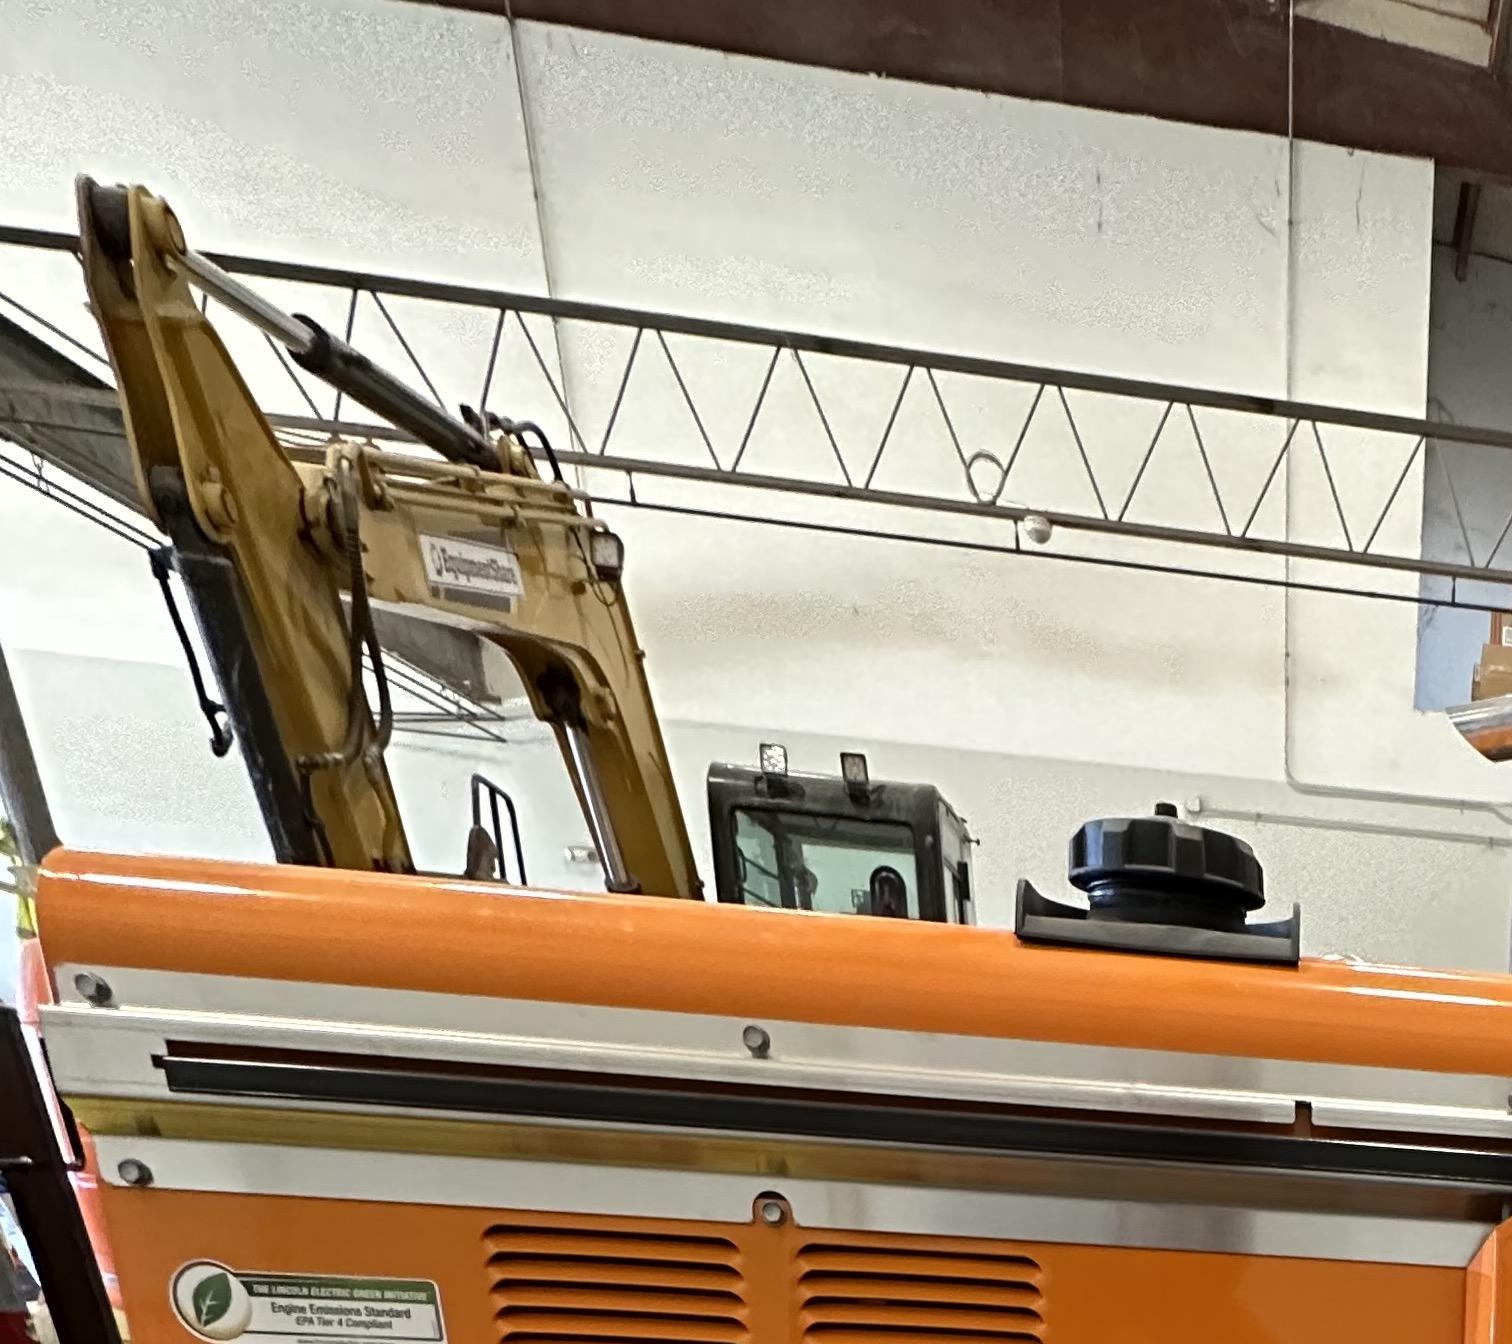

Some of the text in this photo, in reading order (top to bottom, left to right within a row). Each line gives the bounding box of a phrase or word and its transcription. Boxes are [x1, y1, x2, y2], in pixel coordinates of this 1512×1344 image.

[271, 1284, 309, 1296] LINCOLN
[310, 1286, 351, 1298] ELECTRIC
[271, 1302, 411, 1319] Engine Emissions Standard
[295, 1316, 314, 1327] EPA
[317, 1317, 335, 1327] Tier
[345, 1318, 393, 1330] Compliant
